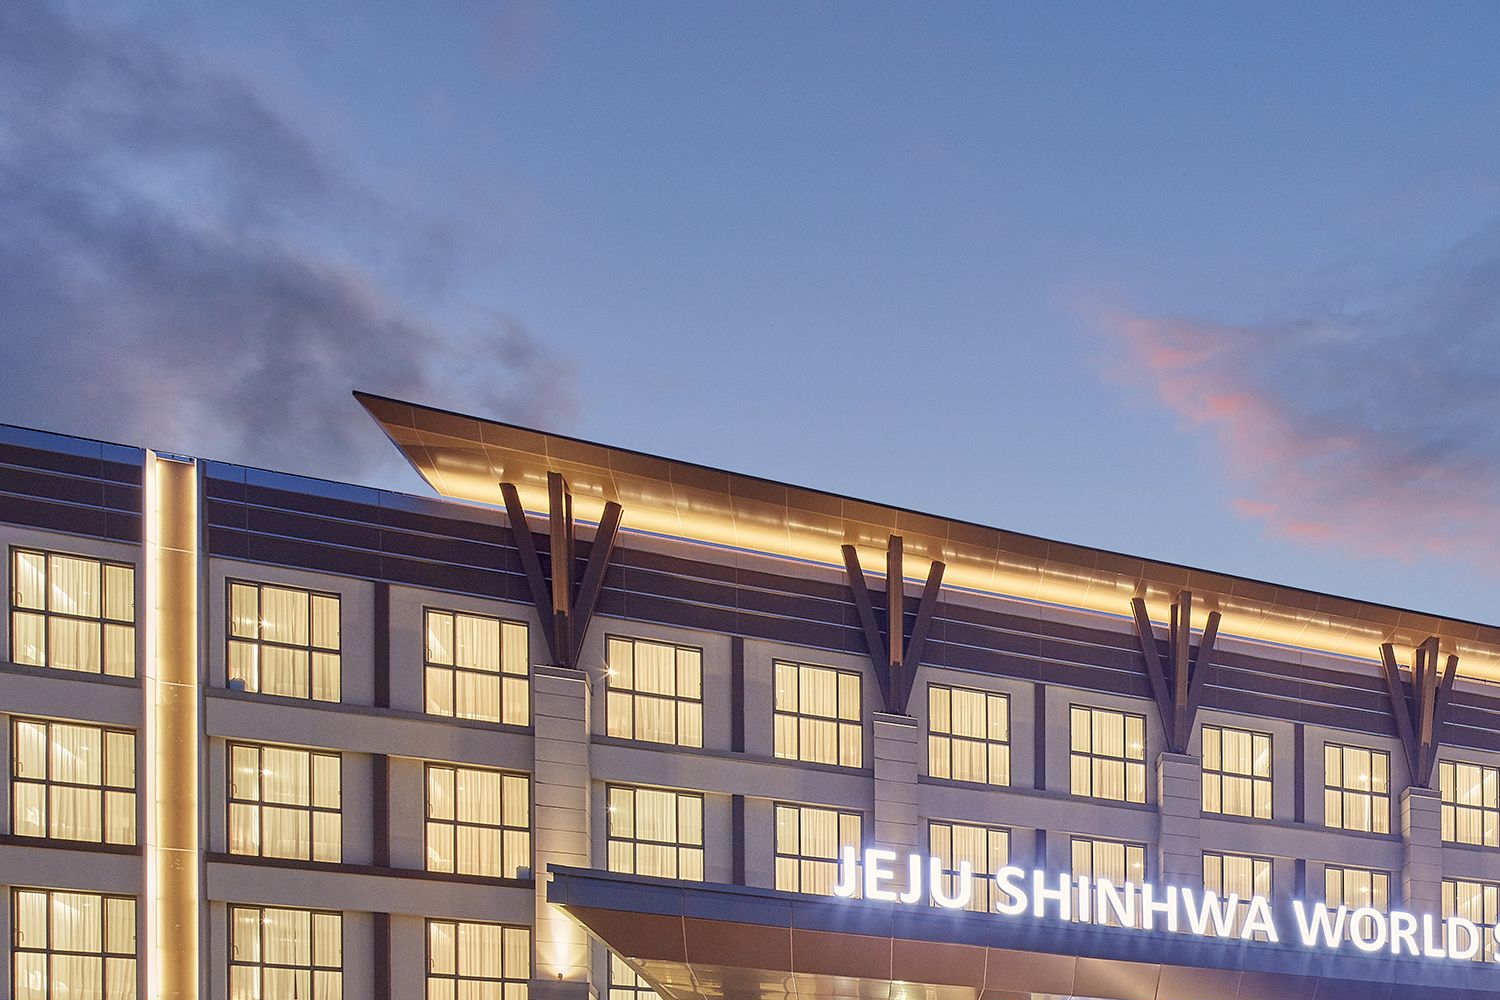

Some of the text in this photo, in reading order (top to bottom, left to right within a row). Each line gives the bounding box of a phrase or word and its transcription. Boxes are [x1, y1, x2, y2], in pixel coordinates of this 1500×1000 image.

[833, 846, 972, 909] JEJU
[996, 866, 1279, 942] SHINHWA
[1293, 900, 1479, 960] WORLD
